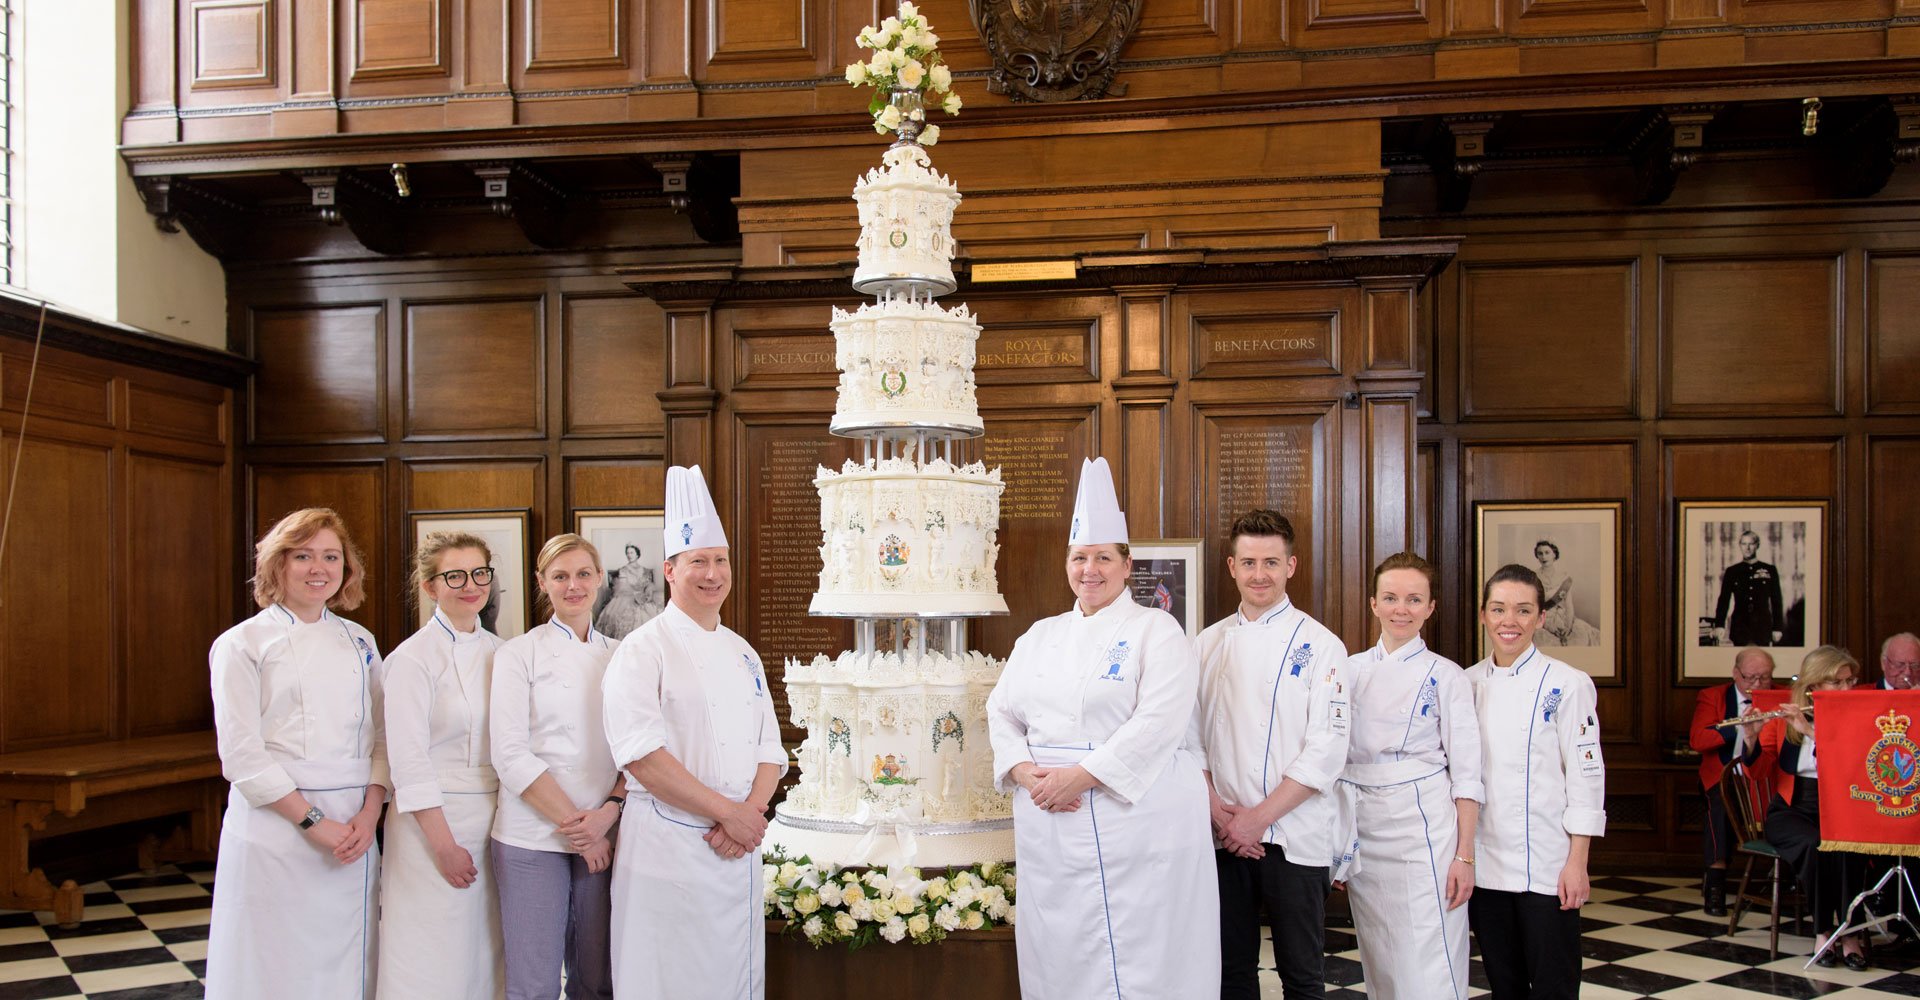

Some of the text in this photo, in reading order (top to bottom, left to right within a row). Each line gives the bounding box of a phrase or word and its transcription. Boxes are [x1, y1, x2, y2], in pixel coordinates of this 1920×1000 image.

[1006, 339, 1050, 352] ROYAL
[1214, 338, 1316, 352] BENEFACTORS
[980, 352, 1076, 365] BENEFACTORS
[1883, 736, 1900, 746] QUI
[1851, 790, 1879, 801] ROYAL
[1878, 804, 1918, 816] HOSPITAL
